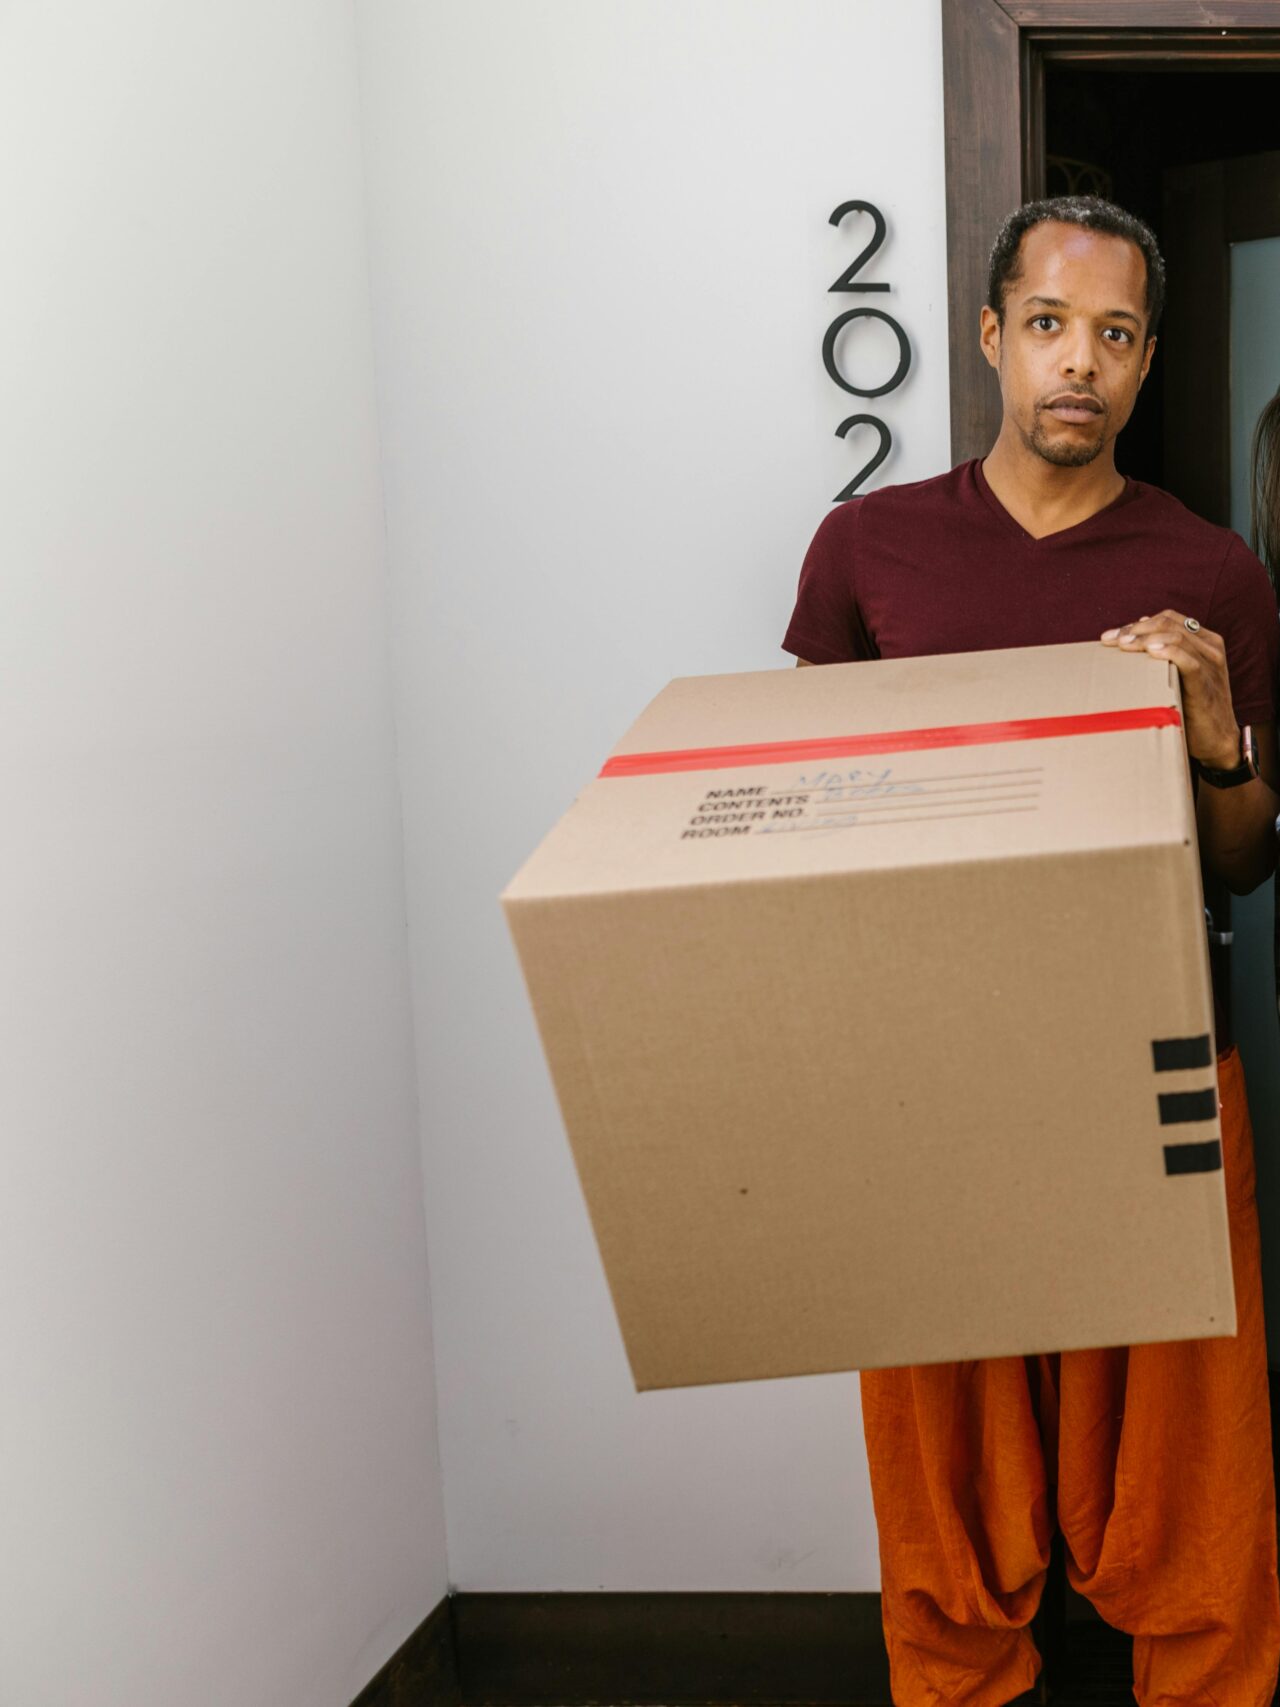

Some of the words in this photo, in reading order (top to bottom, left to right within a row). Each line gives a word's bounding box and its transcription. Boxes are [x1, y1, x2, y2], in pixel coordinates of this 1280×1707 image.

[822, 199, 911, 503] 202
[706, 786, 767, 800] NAME
[698, 795, 809, 812] CONTENTS
[690, 812, 766, 826] ORDER
[681, 826, 751, 840] ROOM
